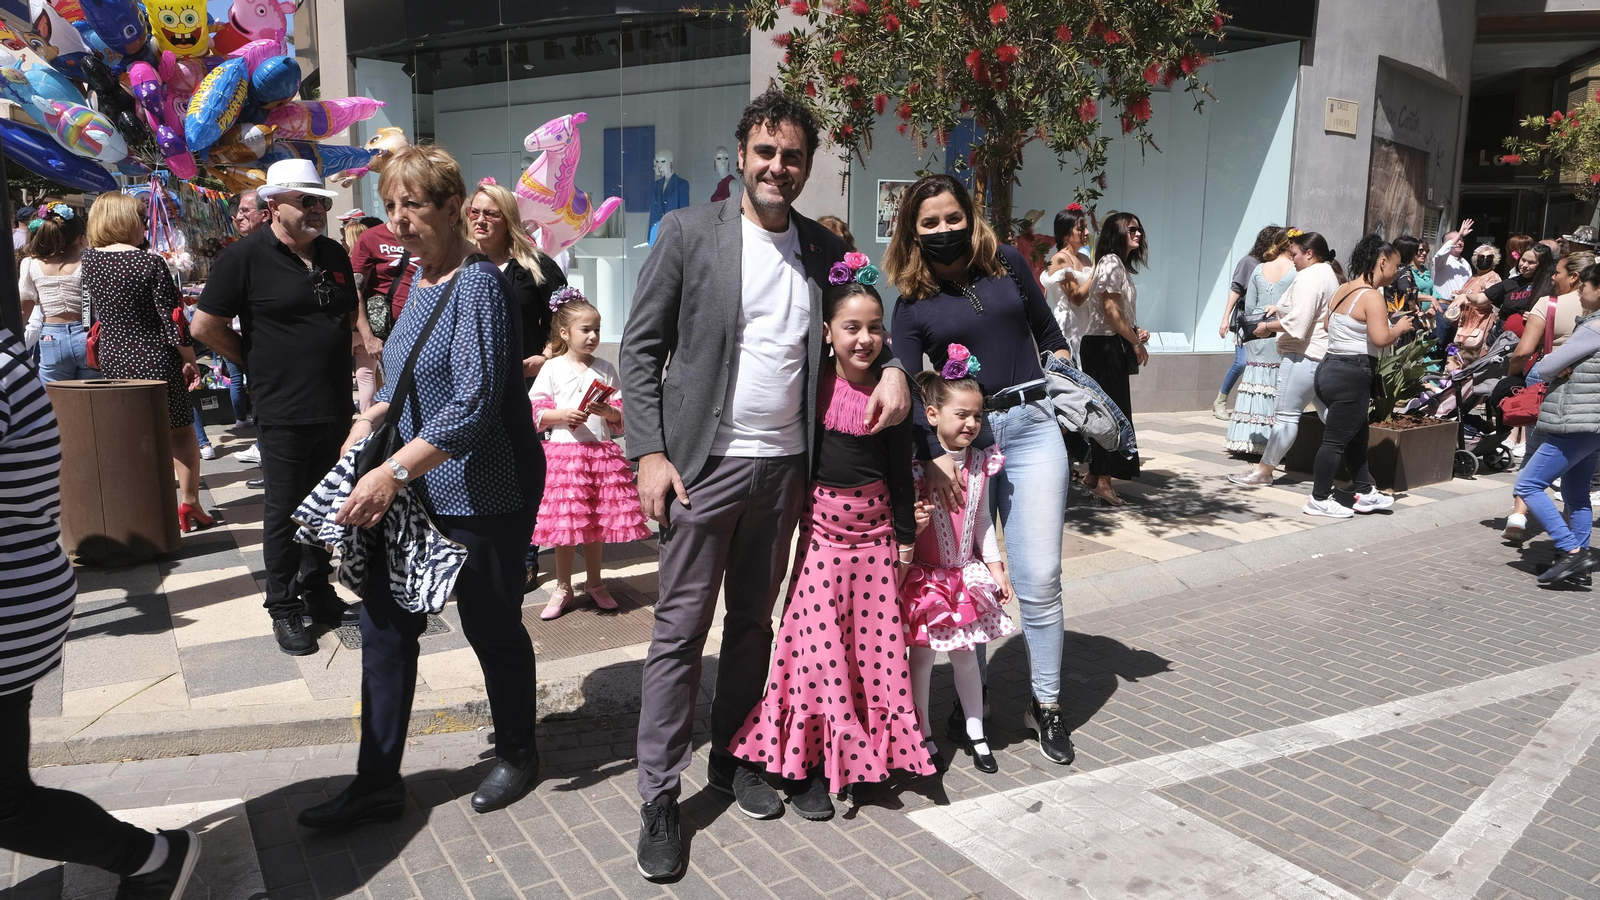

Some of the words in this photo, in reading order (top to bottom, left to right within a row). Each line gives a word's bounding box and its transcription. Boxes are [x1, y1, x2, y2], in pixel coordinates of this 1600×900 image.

[217, 78, 249, 134] SPIDER-MAN
[1337, 101, 1349, 111] CALLE
[1333, 118, 1350, 128] LOBERO
